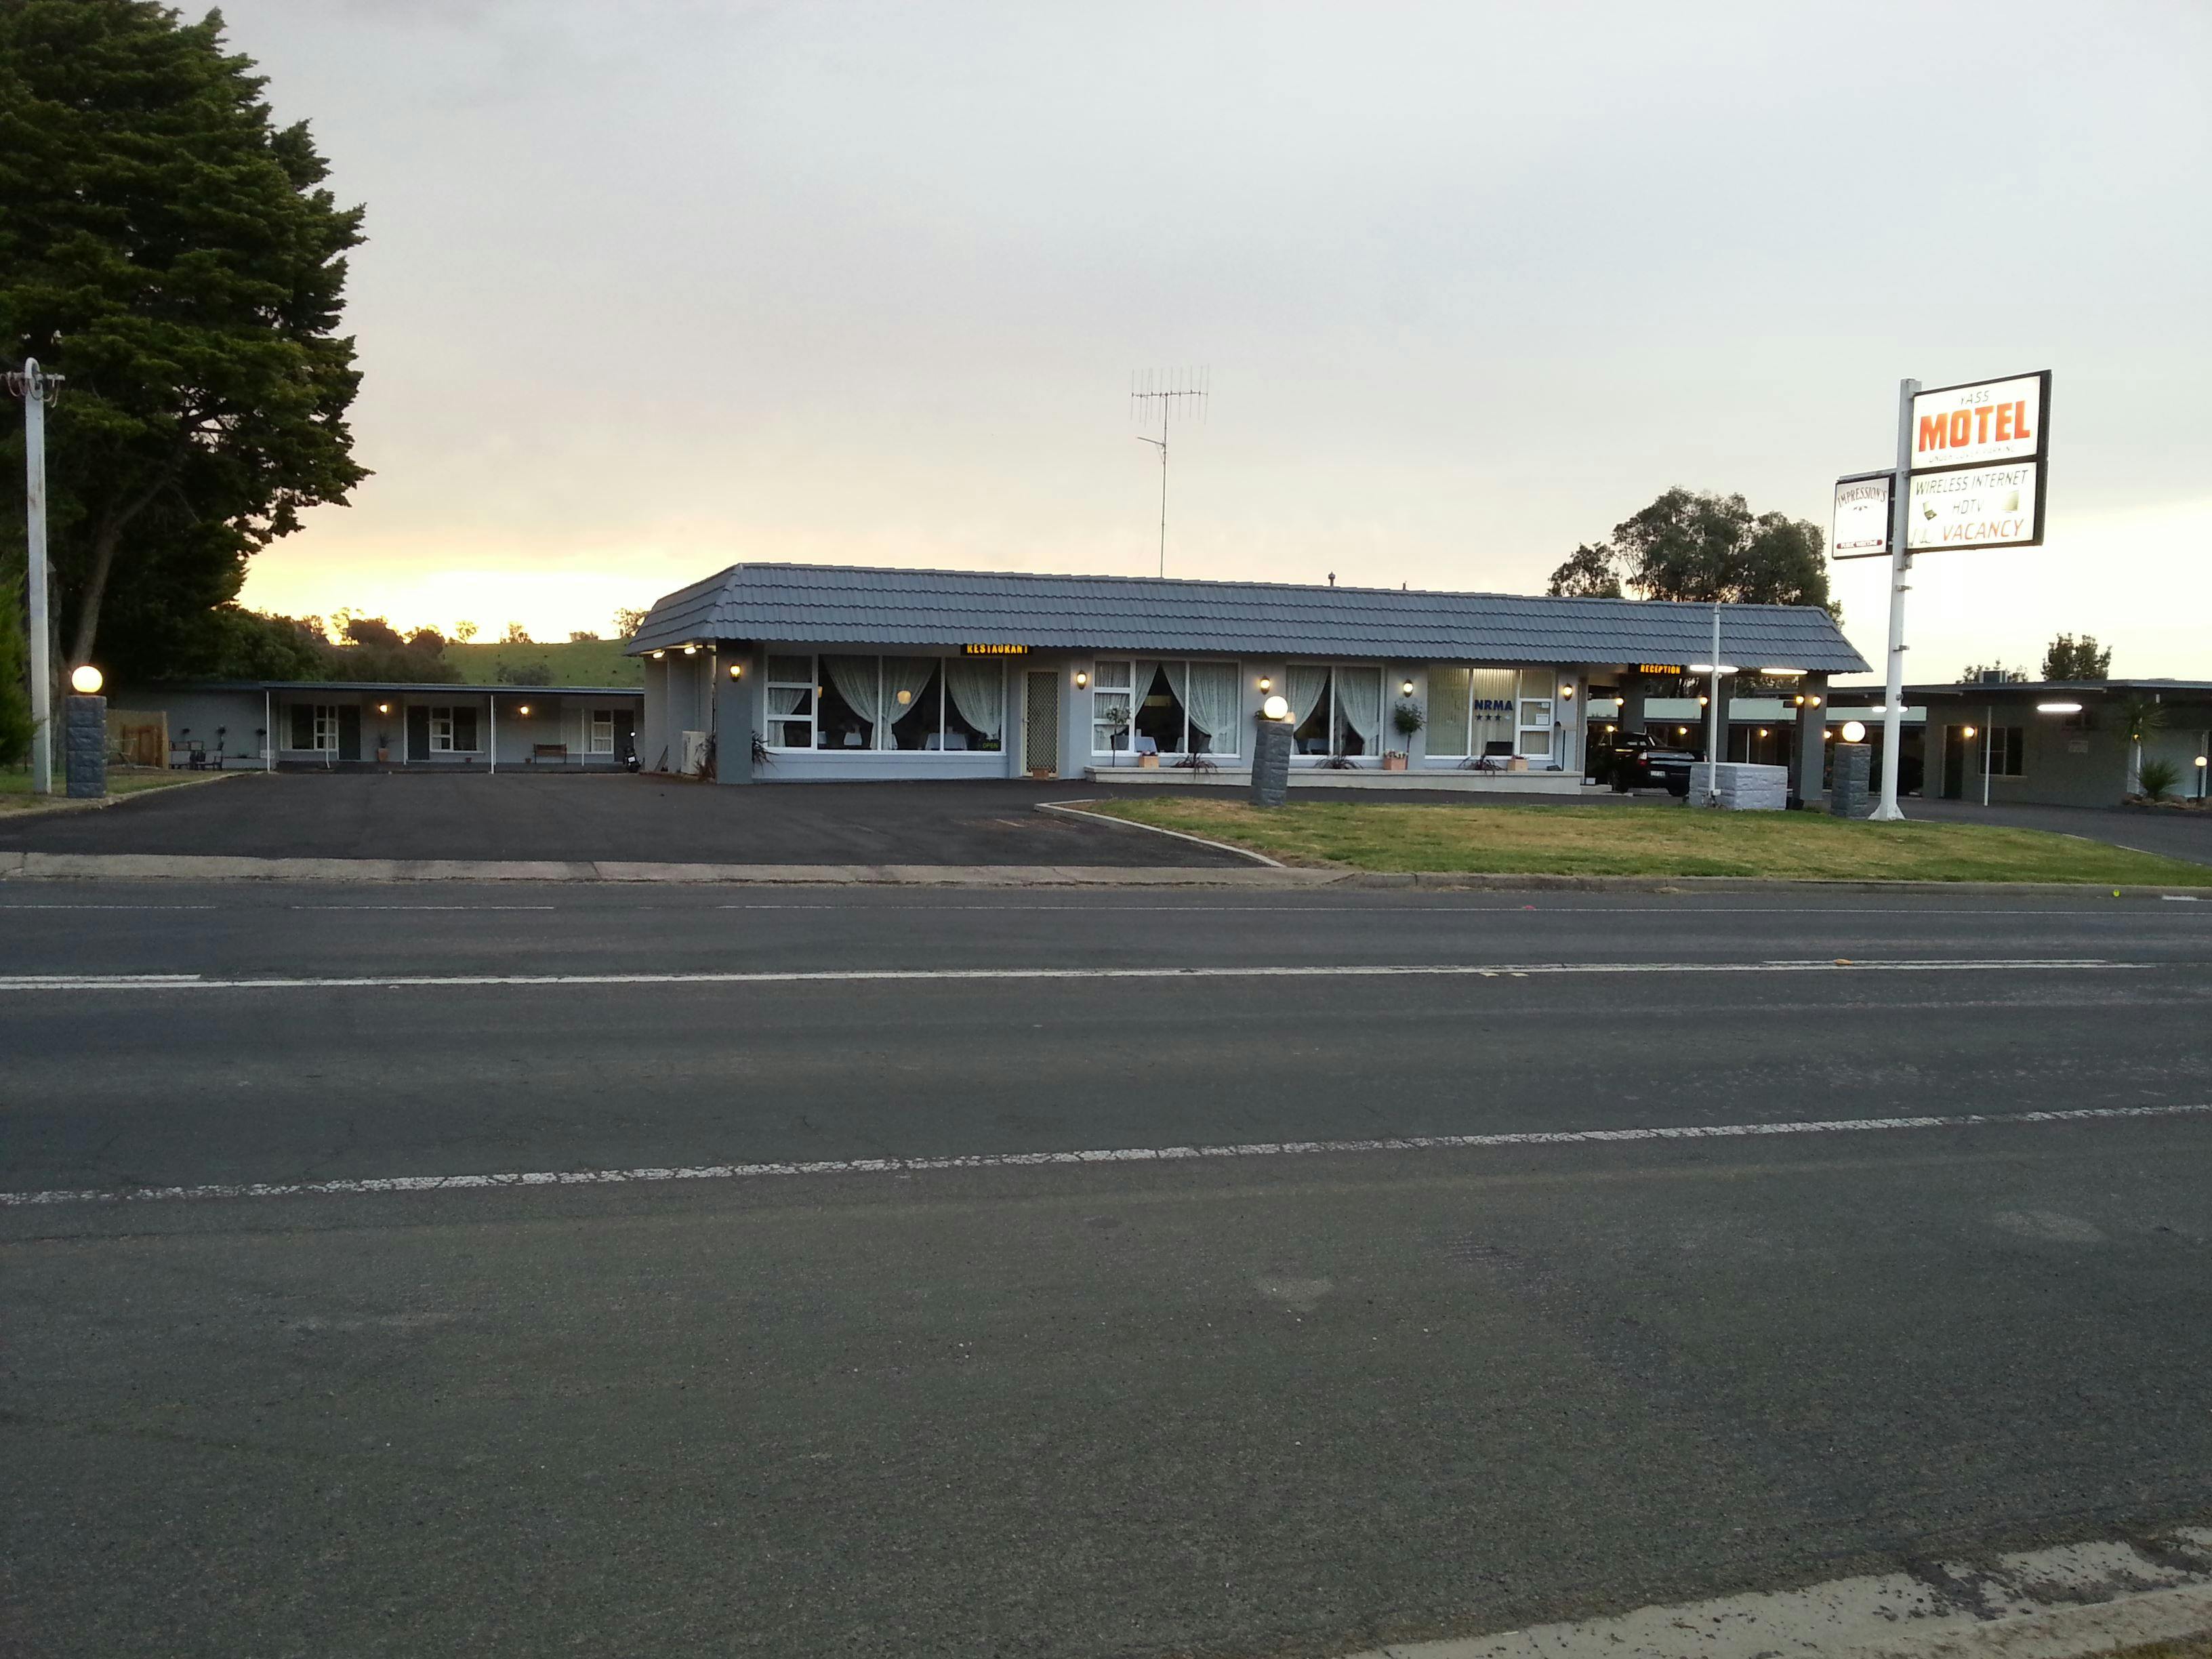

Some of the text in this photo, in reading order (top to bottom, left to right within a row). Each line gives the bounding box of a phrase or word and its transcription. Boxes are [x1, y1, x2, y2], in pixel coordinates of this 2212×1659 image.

[1919, 401, 2030, 452] MOTEL
[1916, 470, 2028, 495] WIRELESS INTERNET
[1952, 499, 1984, 514] HDTV
[1943, 518, 2024, 541] VACANCY
[966, 644, 1028, 654] RESTAURANT
[1640, 664, 1681, 674] RECEPTION
[1474, 699, 1513, 711] NRMA
